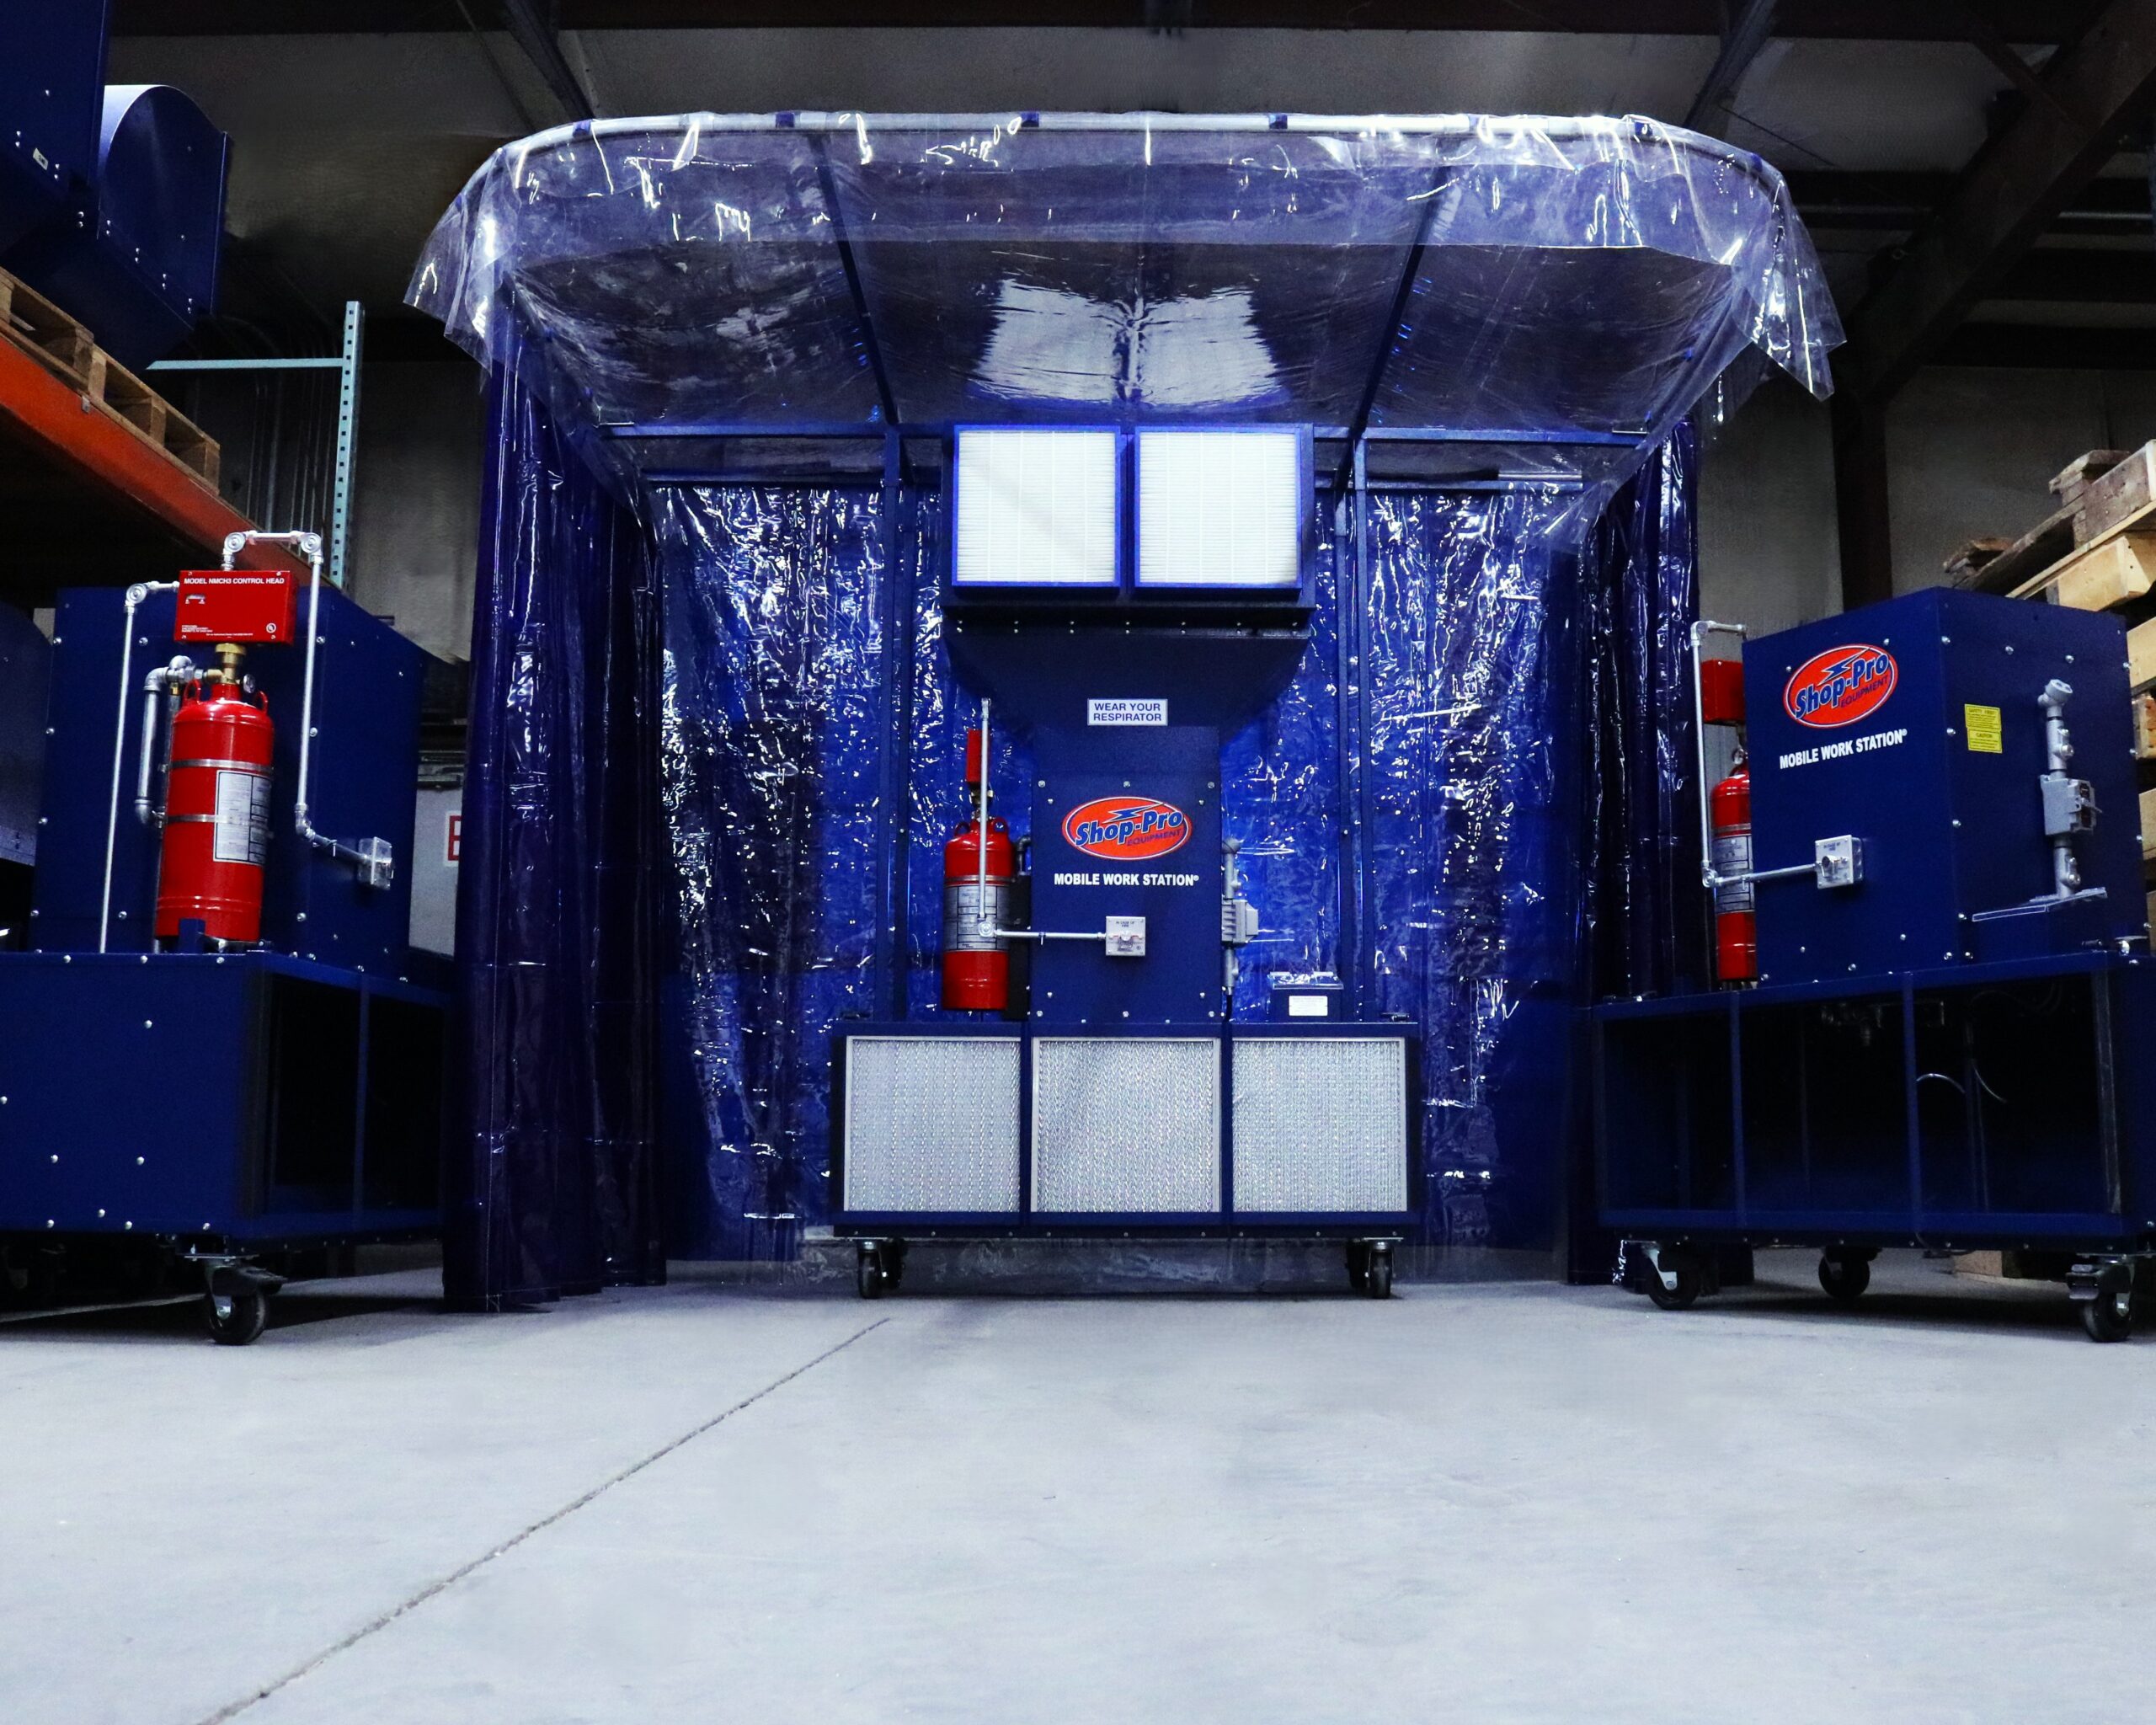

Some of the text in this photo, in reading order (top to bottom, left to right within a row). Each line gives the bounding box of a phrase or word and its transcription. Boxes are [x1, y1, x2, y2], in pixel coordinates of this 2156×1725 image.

[1795, 654, 1889, 719] Shop-Pro
[1840, 676, 1888, 708] EQUIPMENT
[1093, 713, 1162, 721] RESPIRATOR
[1094, 702, 1161, 711] WEAR YOUR
[1780, 748, 1819, 769] MOBILE
[1821, 740, 1854, 760] WORK
[1075, 810, 1184, 847] Shop-Pro
[1126, 829, 1182, 846] EQUIPMENT
[1054, 873, 1100, 885] MOBILE
[1103, 873, 1139, 885] WORK
